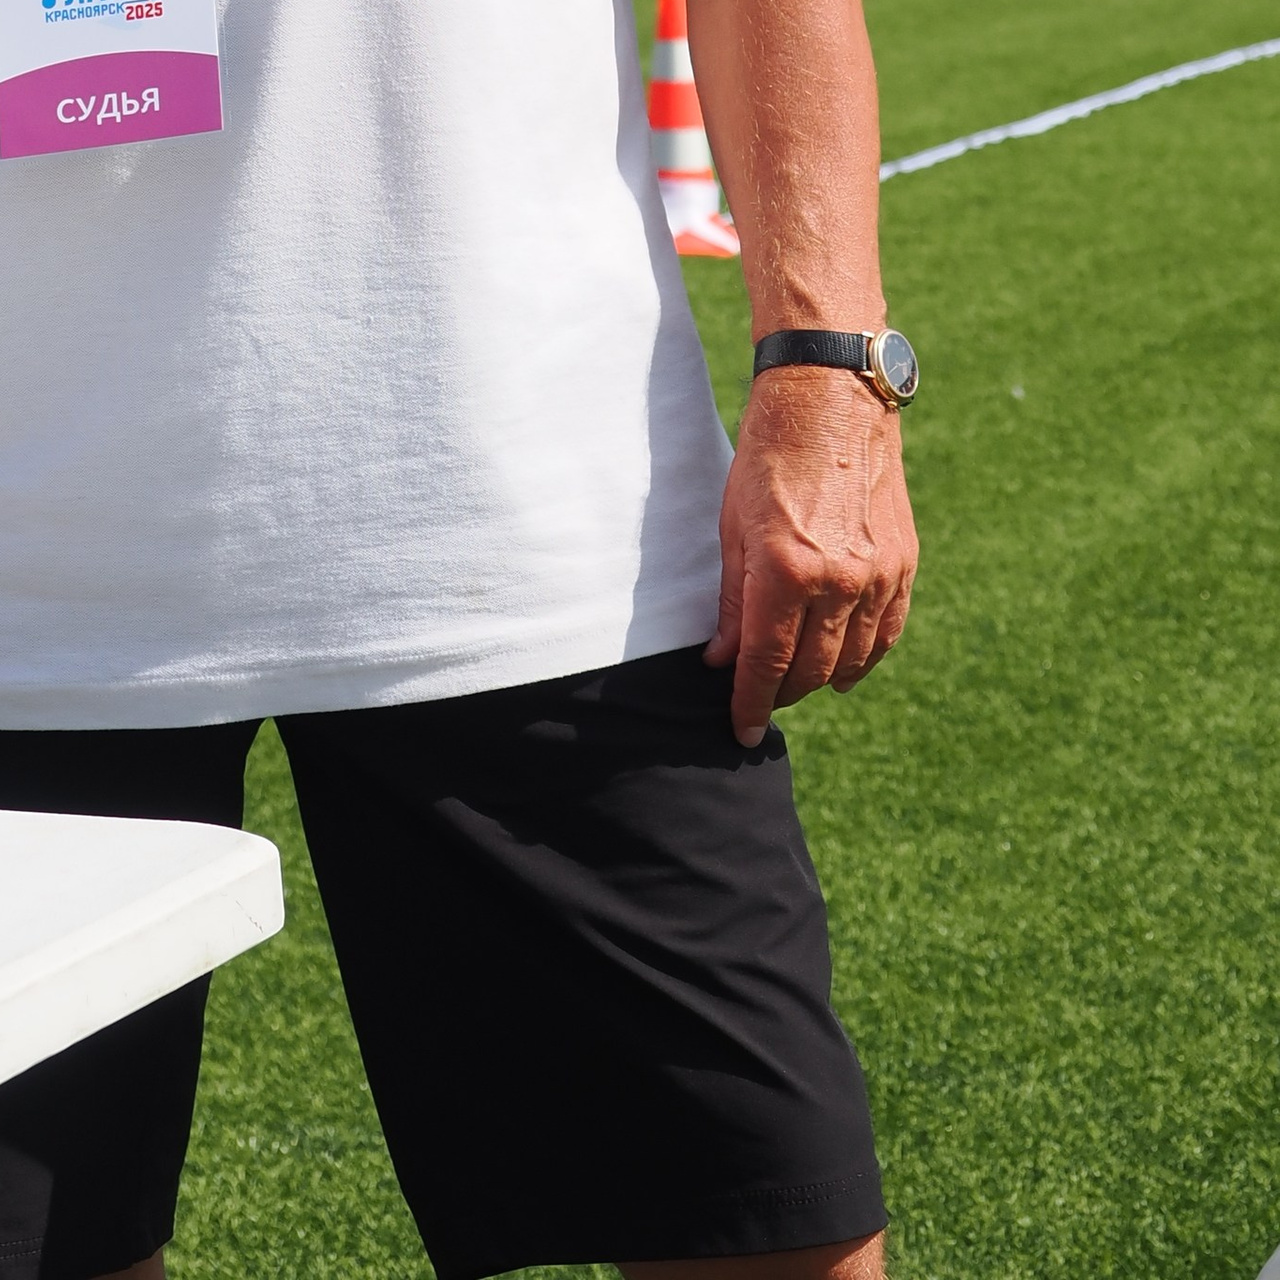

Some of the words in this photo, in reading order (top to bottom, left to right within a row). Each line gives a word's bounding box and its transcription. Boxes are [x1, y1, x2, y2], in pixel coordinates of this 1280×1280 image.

[45, 2, 125, 23] КРАСНОЯРСК
[125, 2, 163, 20] 2025
[56, 87, 161, 125] СУДЬЯ
